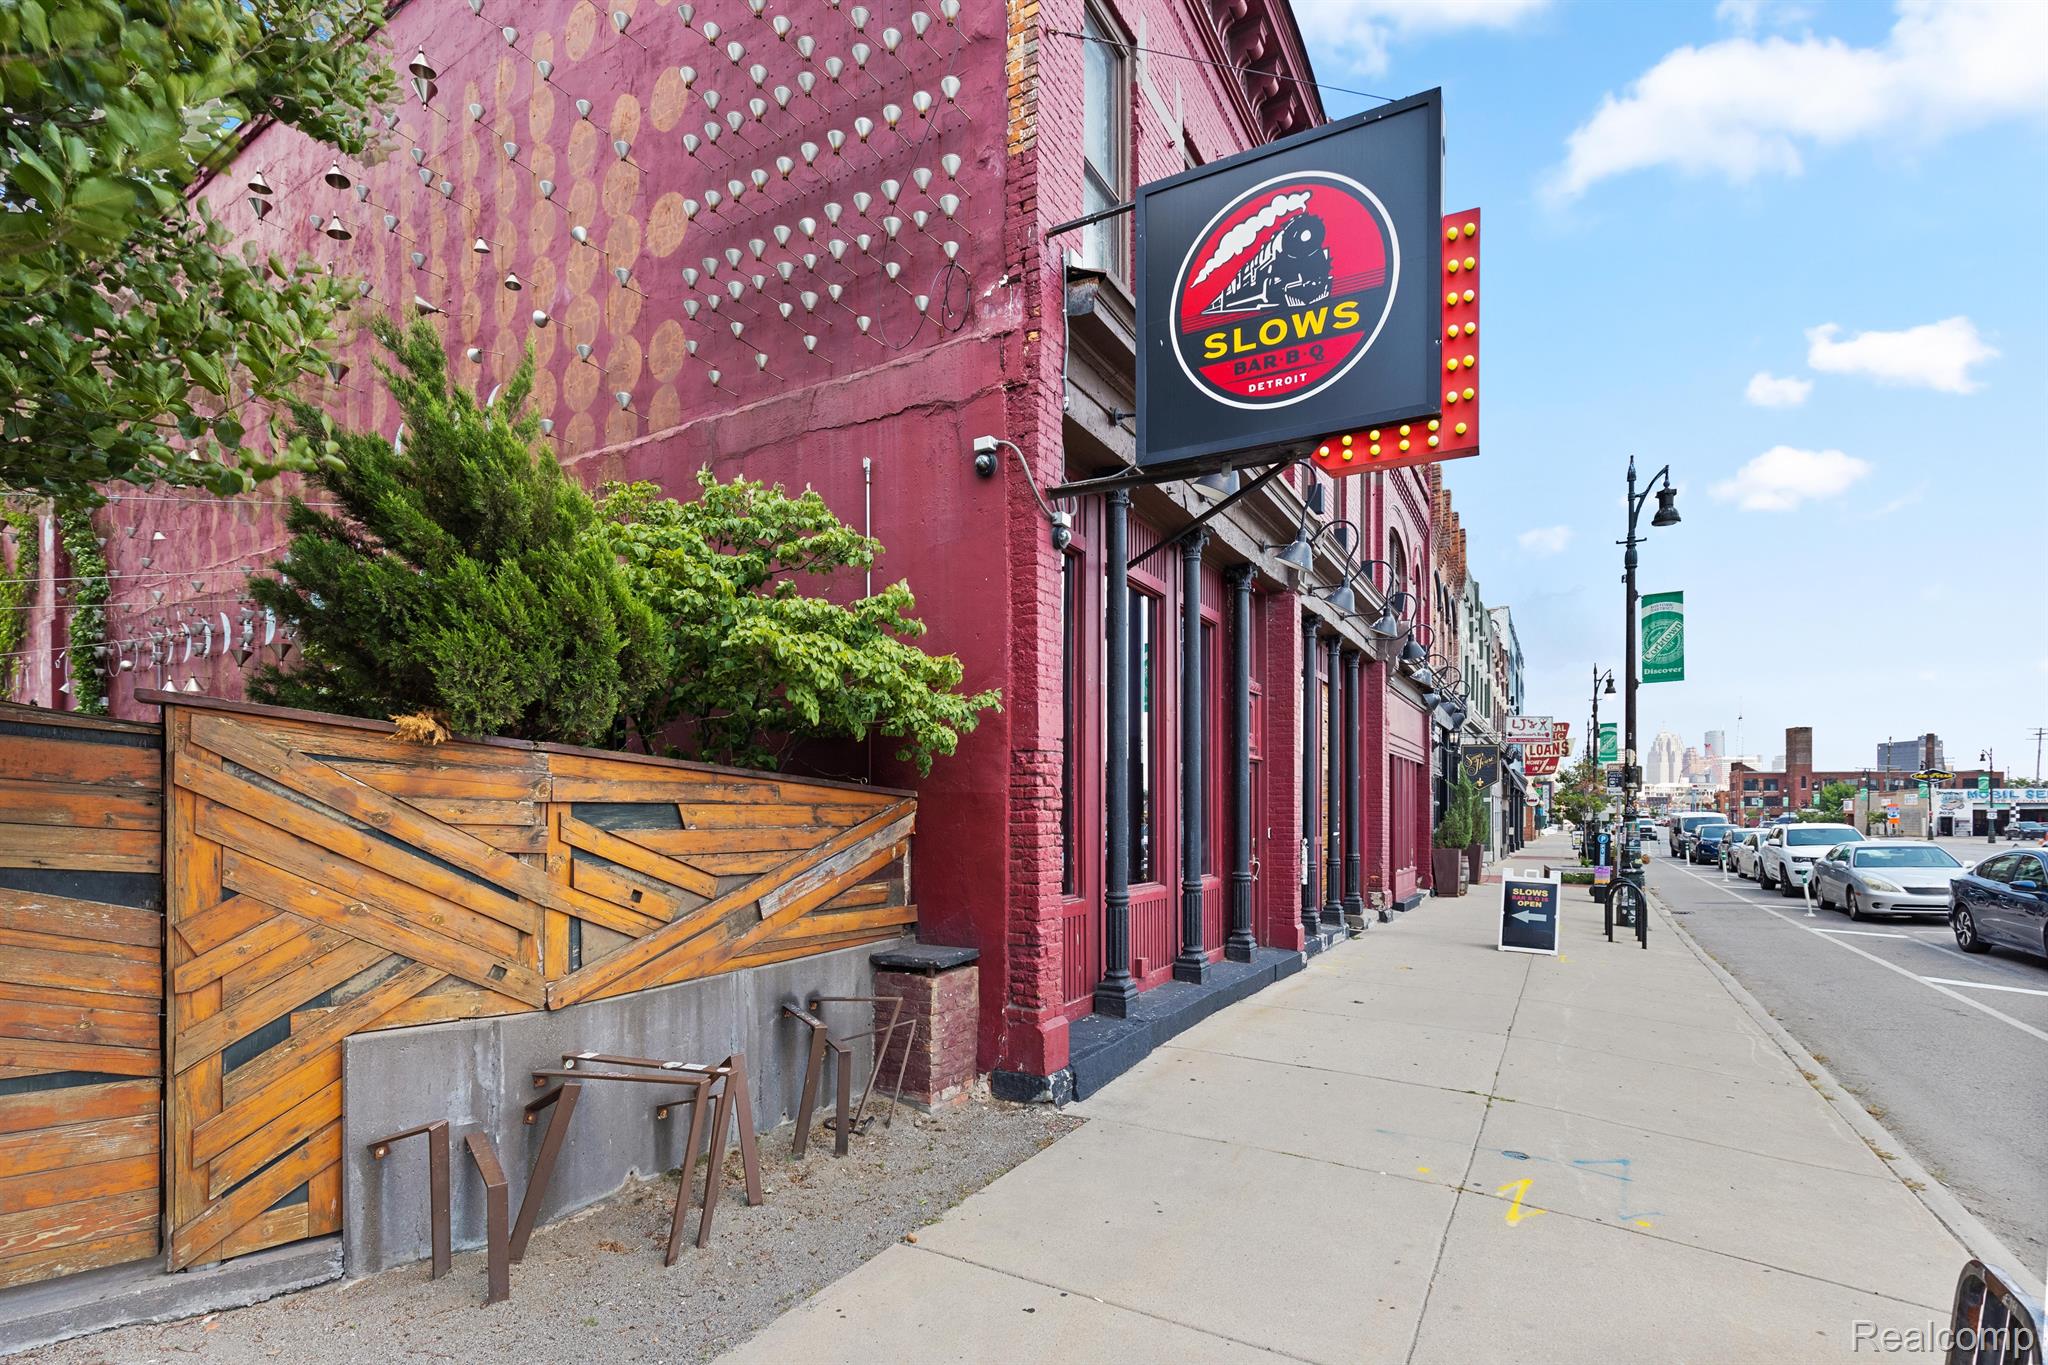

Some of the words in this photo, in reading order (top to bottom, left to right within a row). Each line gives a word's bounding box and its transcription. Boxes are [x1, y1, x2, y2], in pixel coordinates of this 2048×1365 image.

[1203, 300, 1361, 360] SLOWS
[1248, 372, 1308, 393] DETROIT
[1644, 622, 1683, 661] Corktown
[1643, 667, 1683, 676] Discover
[1529, 741, 1569, 757] LOANS
[1967, 790, 2019, 799] MOBIL
[2025, 790, 2048, 800] SE
[1512, 888, 1549, 897] SLOWS
[1517, 900, 1543, 908] OPEN
